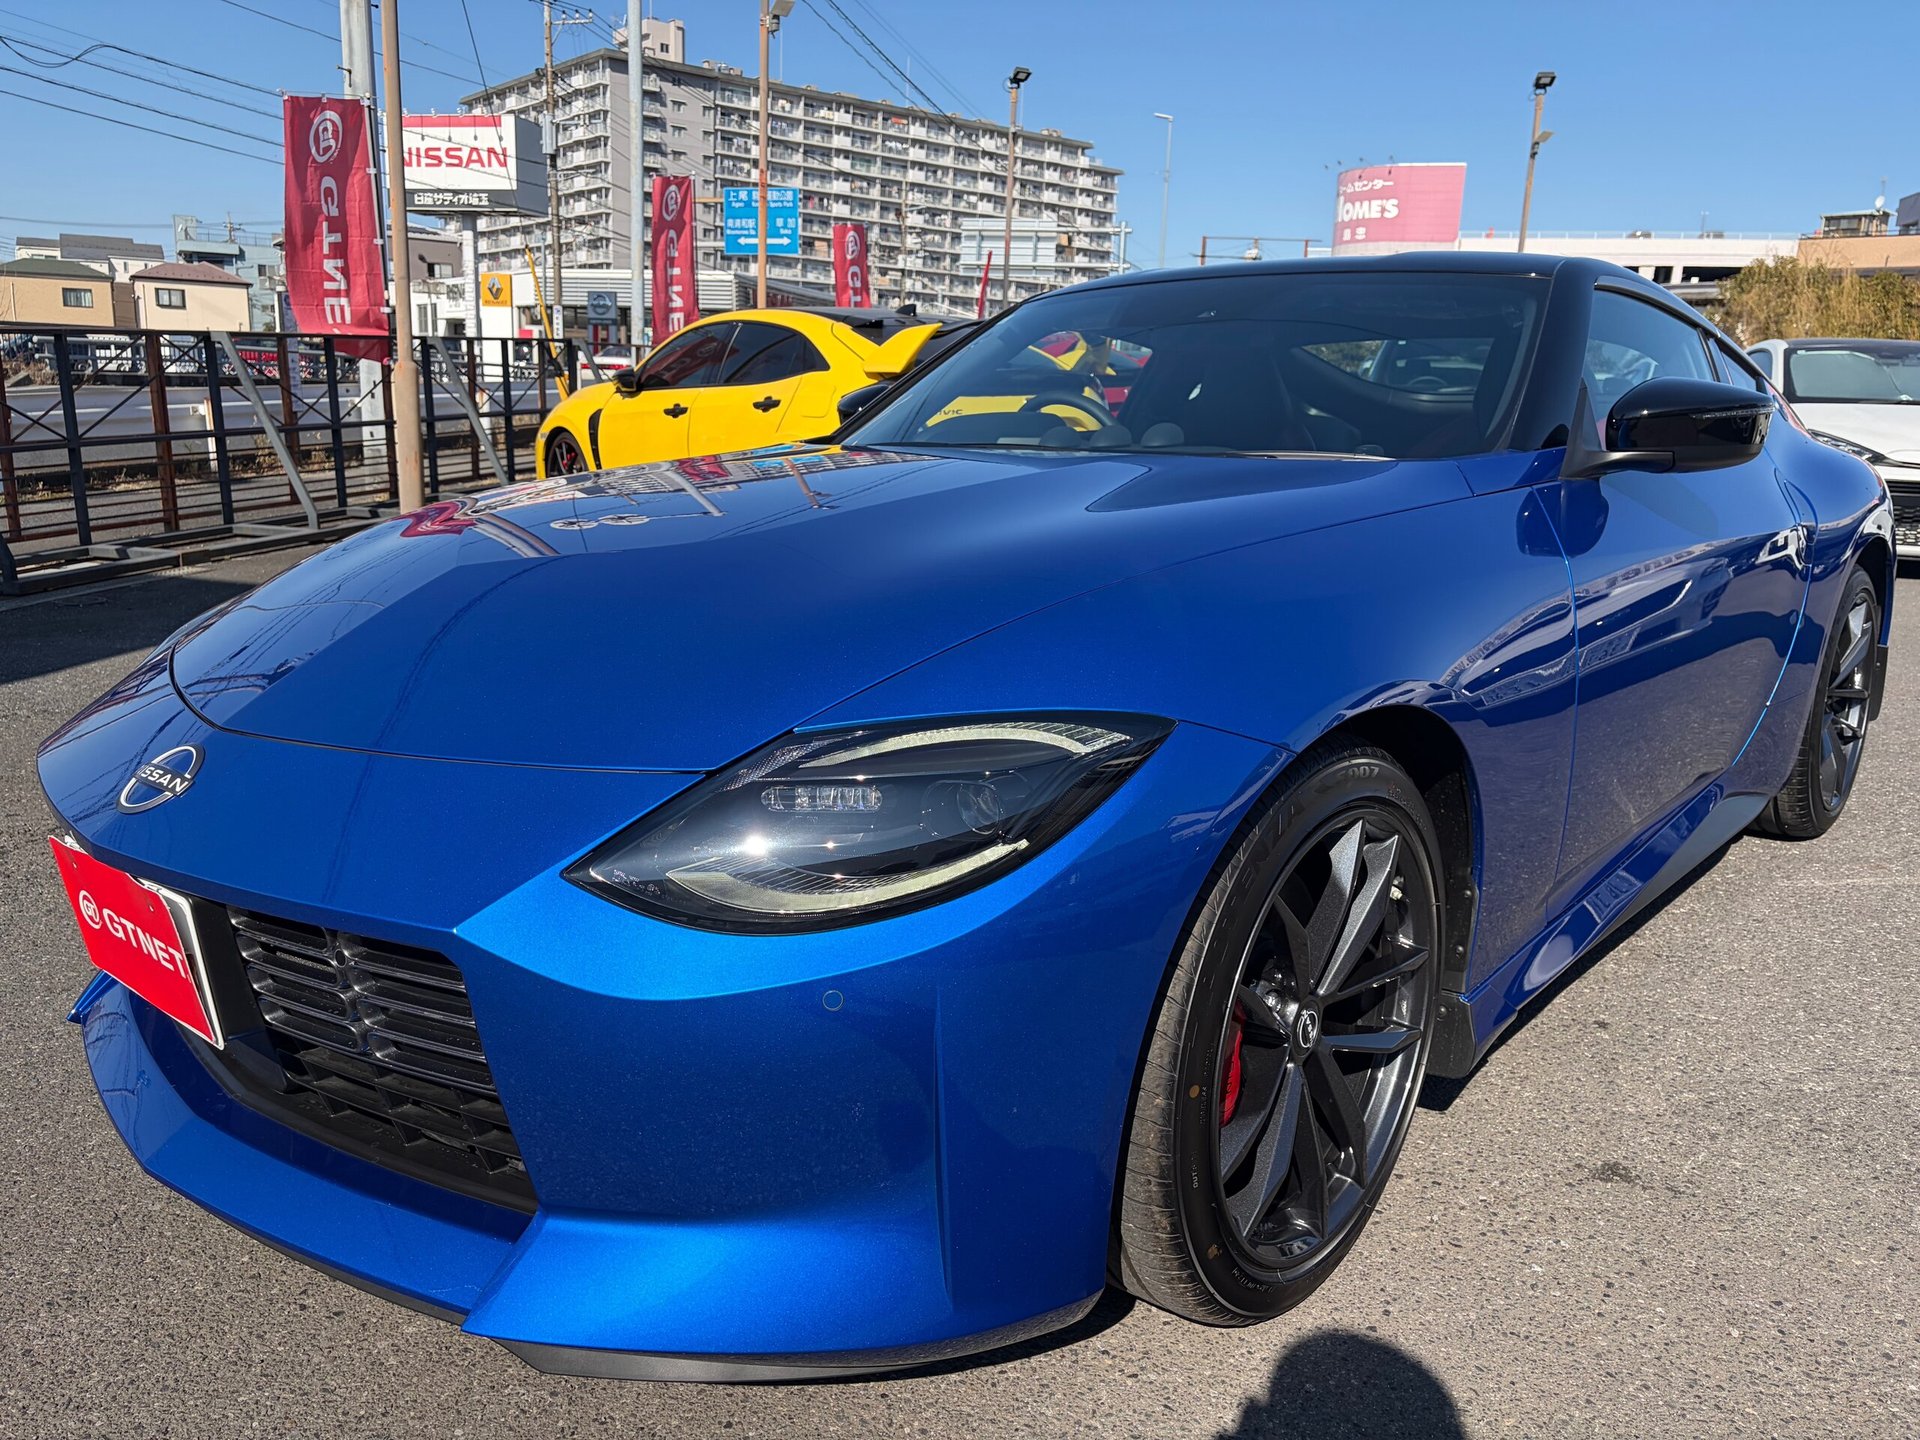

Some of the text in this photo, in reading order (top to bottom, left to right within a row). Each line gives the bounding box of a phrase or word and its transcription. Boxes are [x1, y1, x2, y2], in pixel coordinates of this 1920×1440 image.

[413, 192, 490, 206] 日産サティオ埼玉
[102, 908, 186, 980] GTNET
